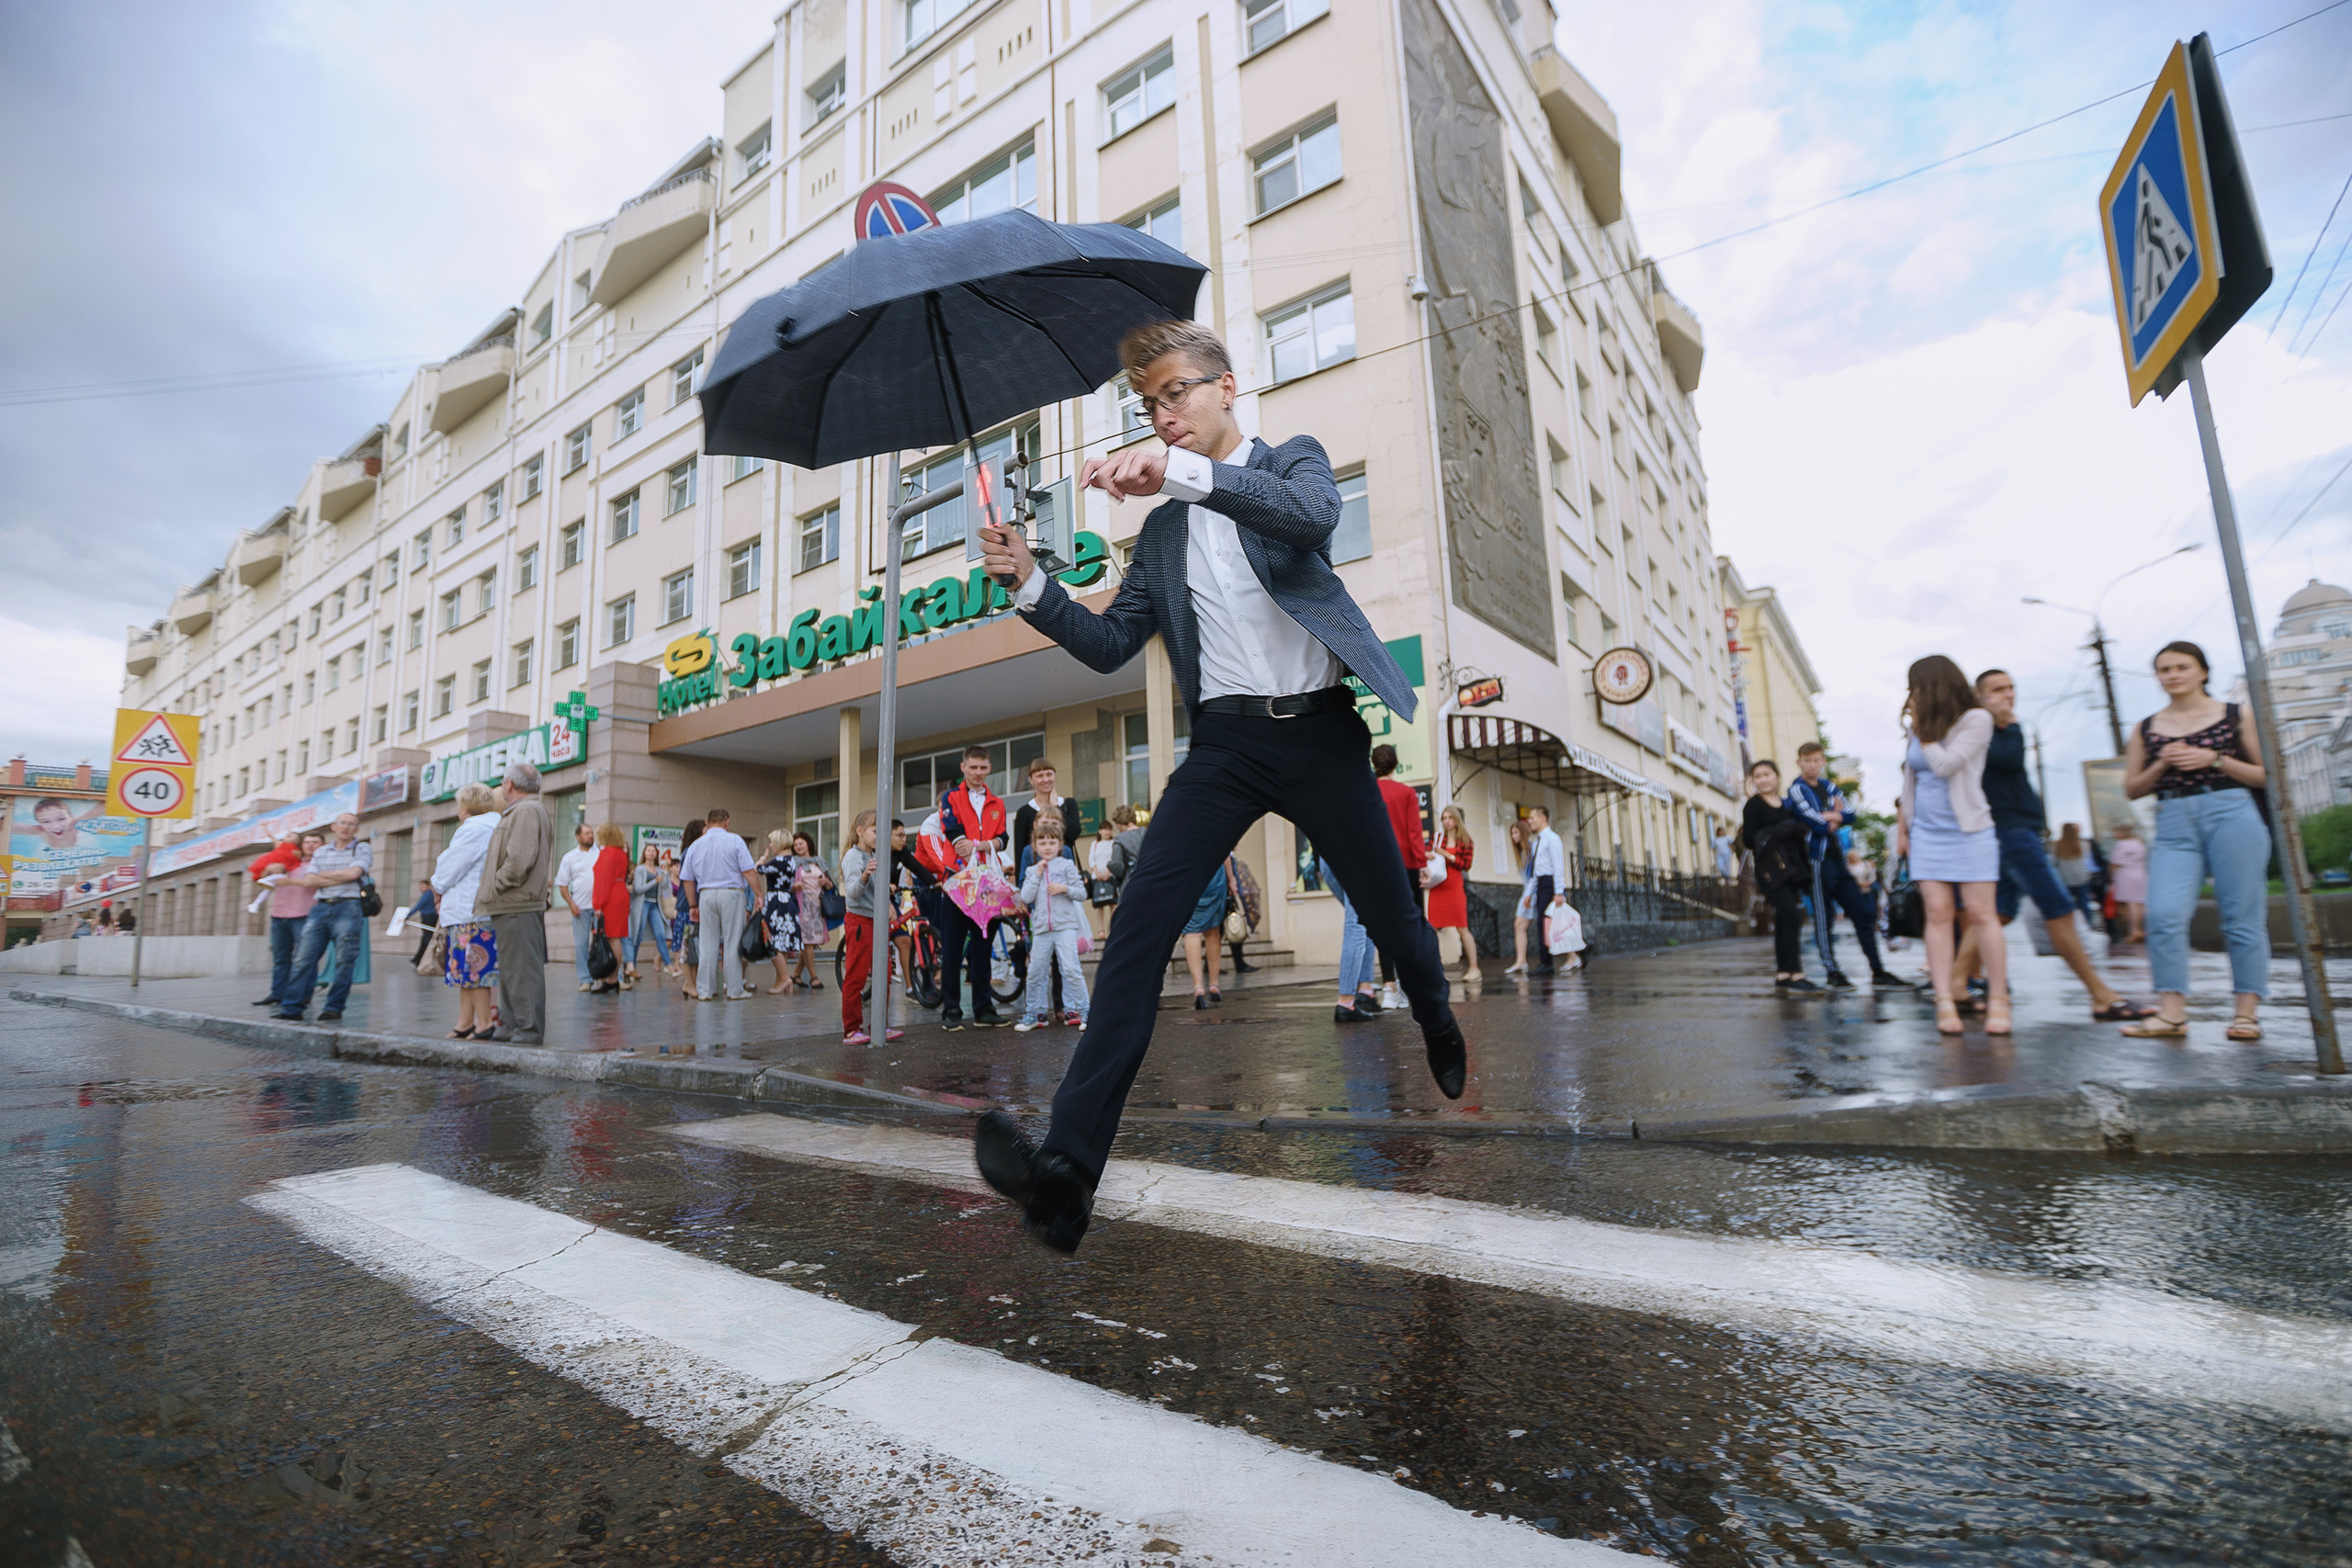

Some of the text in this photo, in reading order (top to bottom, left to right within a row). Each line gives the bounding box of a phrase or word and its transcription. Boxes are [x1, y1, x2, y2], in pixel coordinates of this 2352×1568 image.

[729, 530, 1111, 688] Забайкале
[657, 661, 722, 716] Hotel
[551, 745, 571, 760] часа
[552, 724, 571, 747] 24
[443, 730, 548, 793] АПТЕКА
[133, 781, 169, 800] 40
